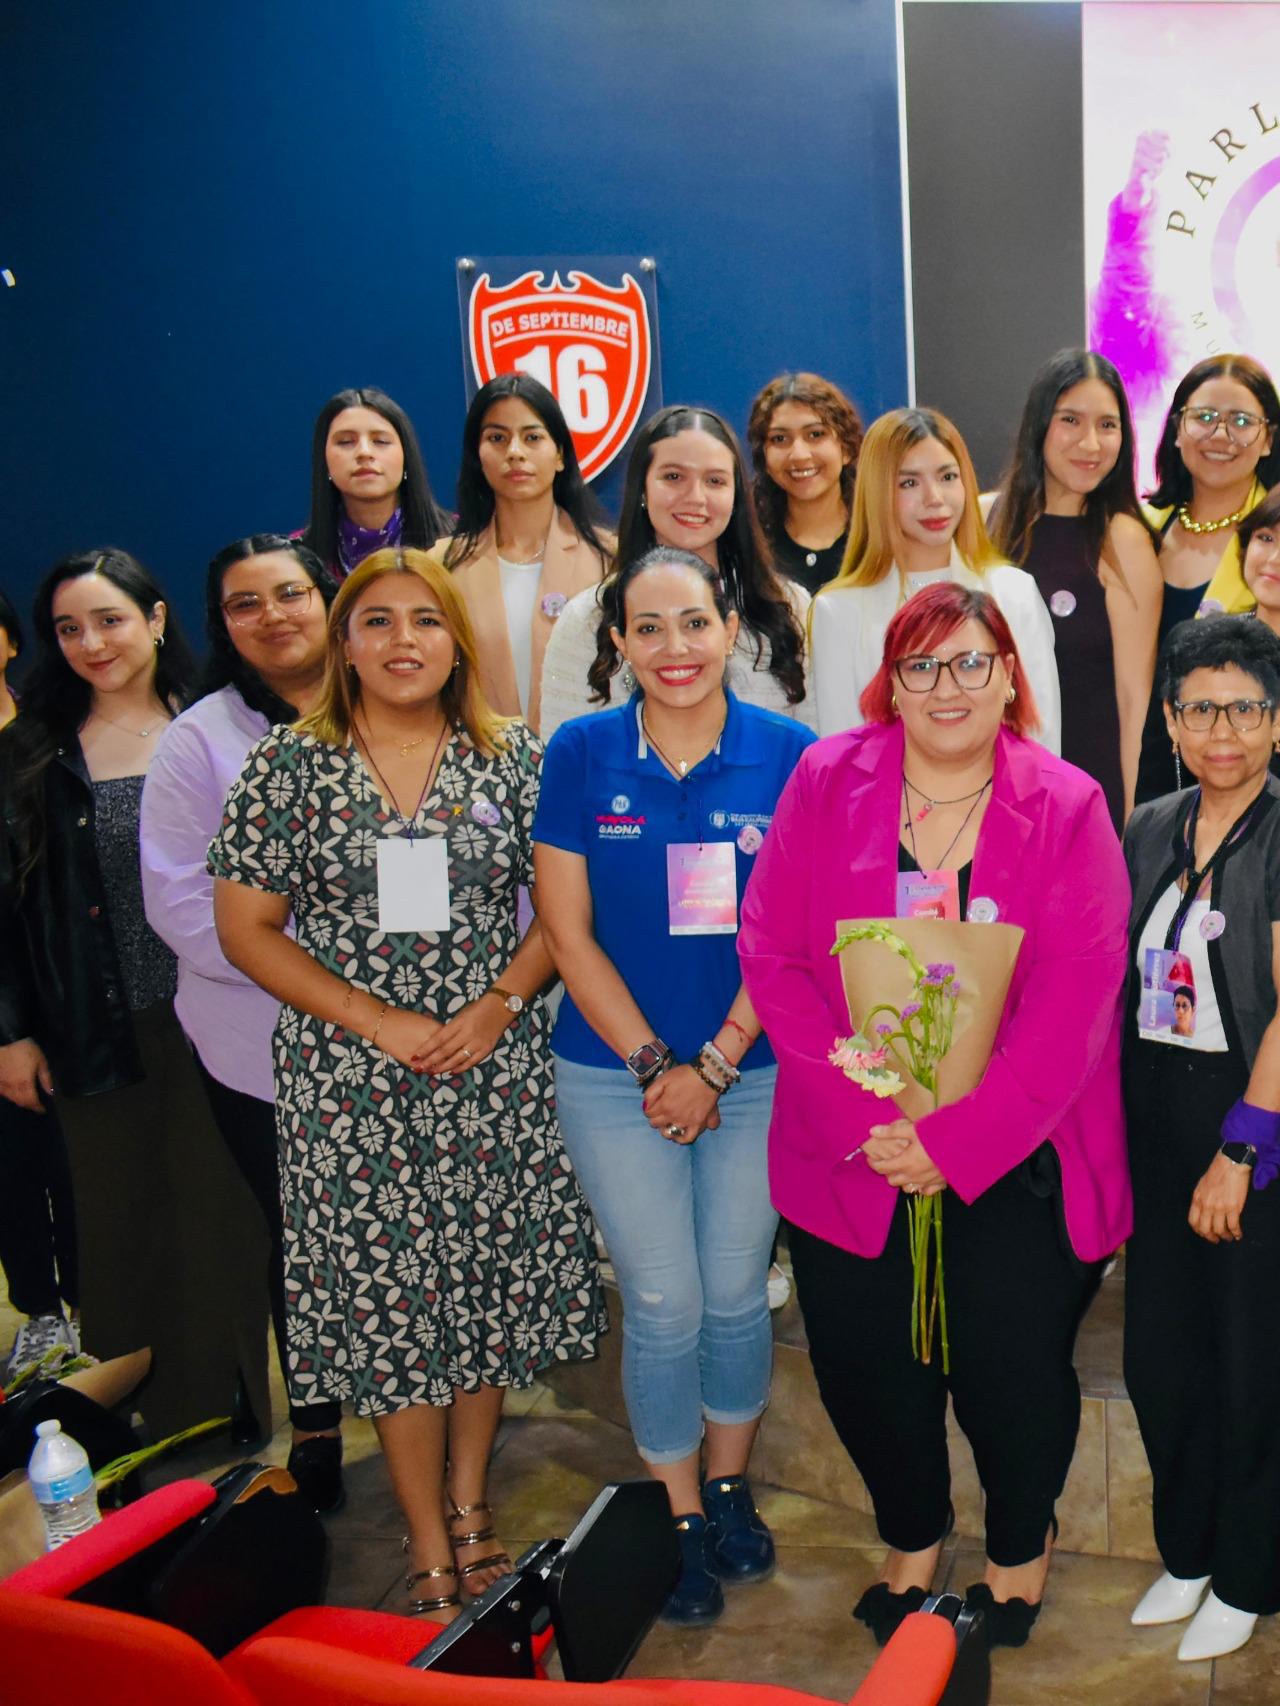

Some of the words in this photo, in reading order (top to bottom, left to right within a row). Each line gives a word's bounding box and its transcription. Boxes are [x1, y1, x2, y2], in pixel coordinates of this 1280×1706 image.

[490, 317, 515, 337] DE
[518, 312, 629, 339] SEPTIEMBRE
[598, 824, 642, 835] GAONA
